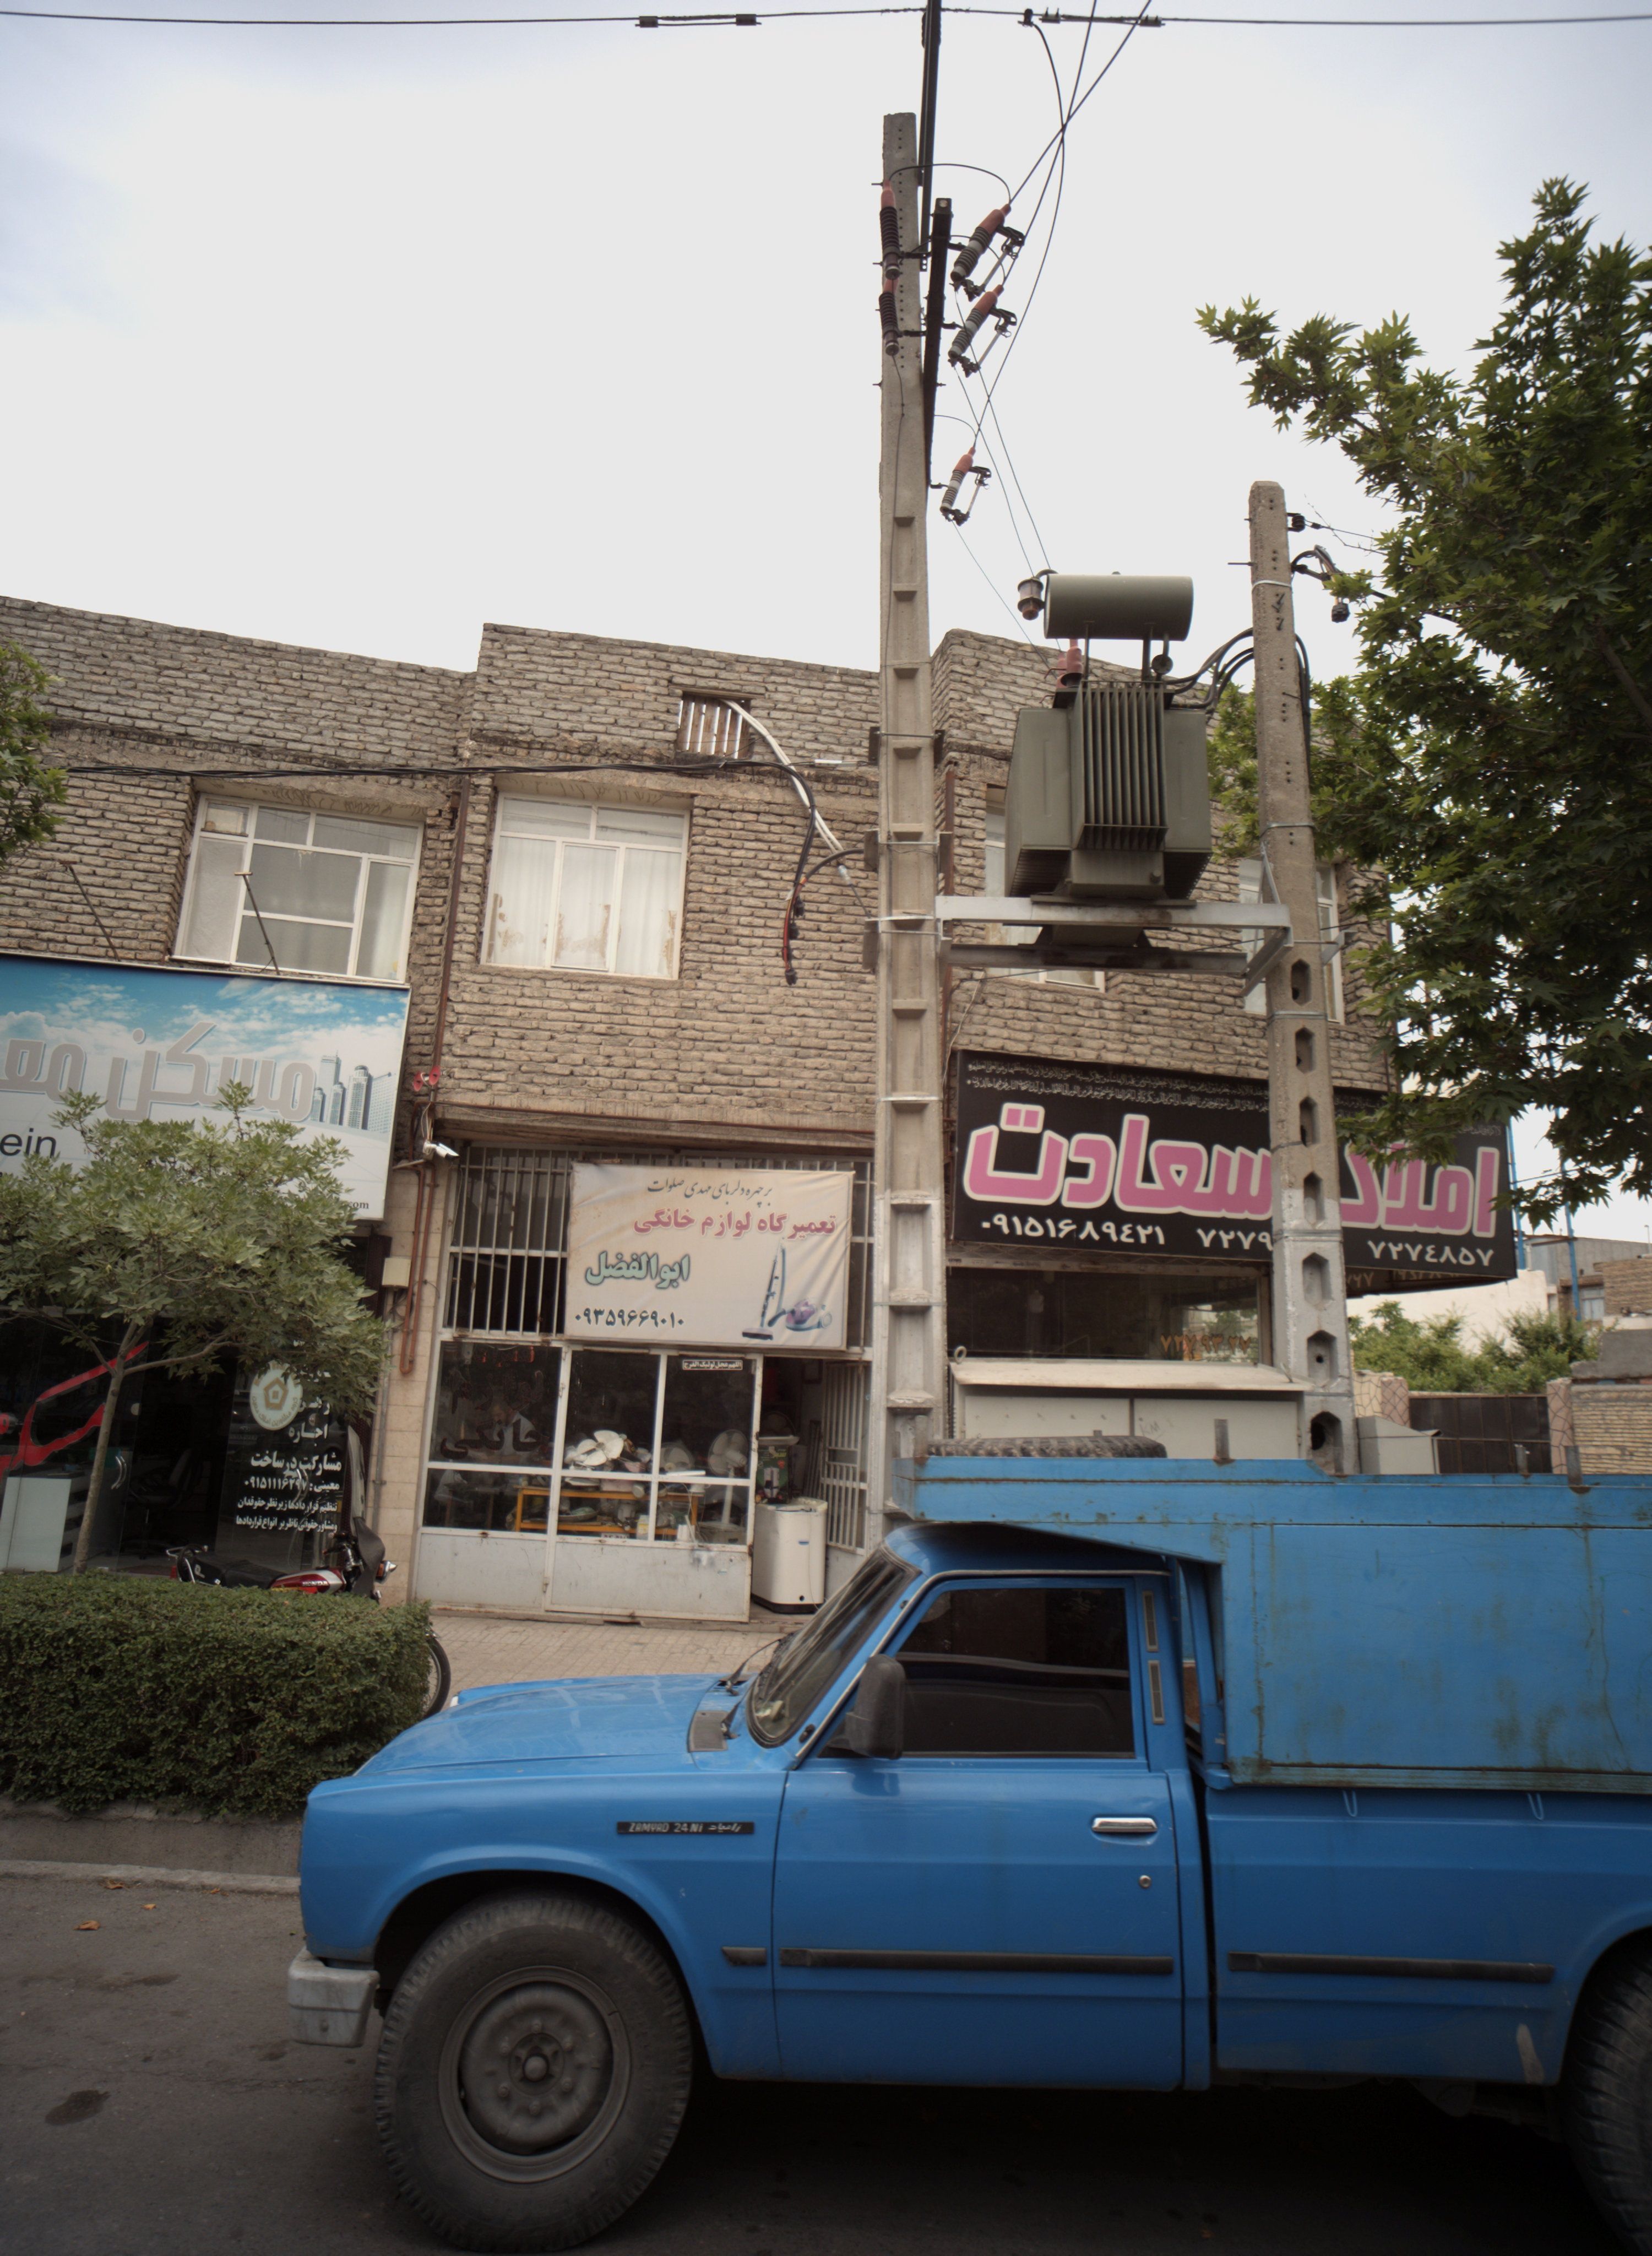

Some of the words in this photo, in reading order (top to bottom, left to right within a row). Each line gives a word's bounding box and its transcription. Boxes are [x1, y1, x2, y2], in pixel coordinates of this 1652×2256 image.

[105, 1022, 317, 1122] مسکن
[963, 1102, 1273, 1221] سعادت
[648, 1177, 684, 1193] صلوات
[684, 1183, 712, 1198] مهدی
[634, 1207, 695, 1234] خانگی
[701, 1210, 752, 1238] لوازم
[585, 1250, 691, 1290] ابوالفضل
[289, 1421, 329, 1447] اجاره
[251, 1450, 284, 1468] ساخت
[299, 1451, 342, 1476] مشارکت
[628, 1823, 670, 1832] ZAMYAD
